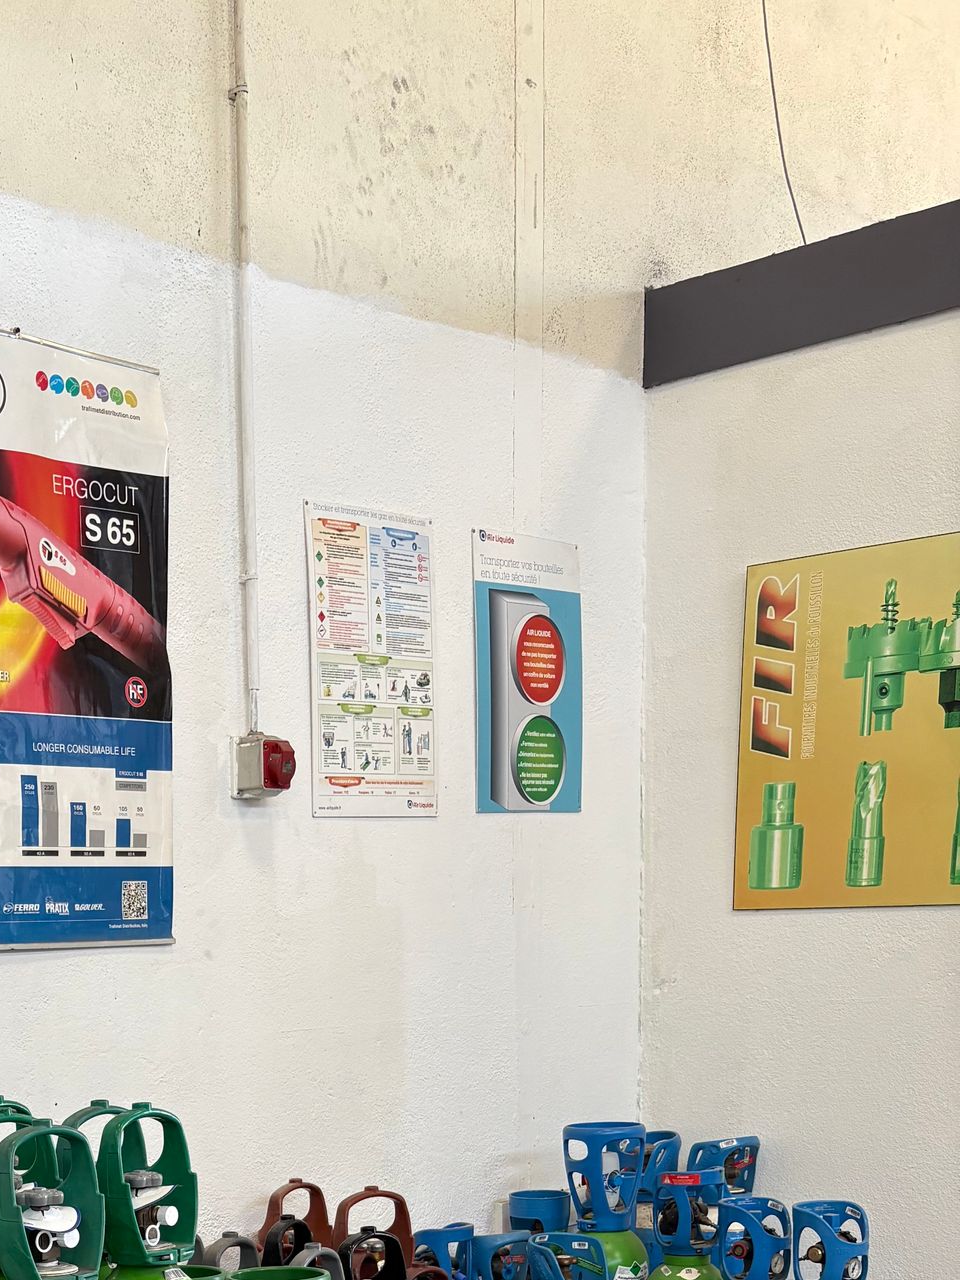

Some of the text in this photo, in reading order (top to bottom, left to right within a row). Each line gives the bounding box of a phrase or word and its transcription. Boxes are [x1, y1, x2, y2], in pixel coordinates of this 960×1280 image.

[52, 474, 139, 506] ERGOCUT
[85, 513, 136, 547] S 65
[486, 533, 515, 545] Air Liquide
[480, 554, 564, 576] Transportez vos bouteilles
[480, 569, 538, 585] en toute sécurité
[534, 629, 552, 638] LIQUIDE
[749, 573, 800, 760] FIR
[801, 569, 824, 761] FOURNITURES INDUSTRIELLES du ROUSSILLON
[32, 742, 136, 757] LONGER CONSUMABLE LIFE
[14, 903, 40, 912] FERRO
[45, 902, 69, 914] PRATIX
